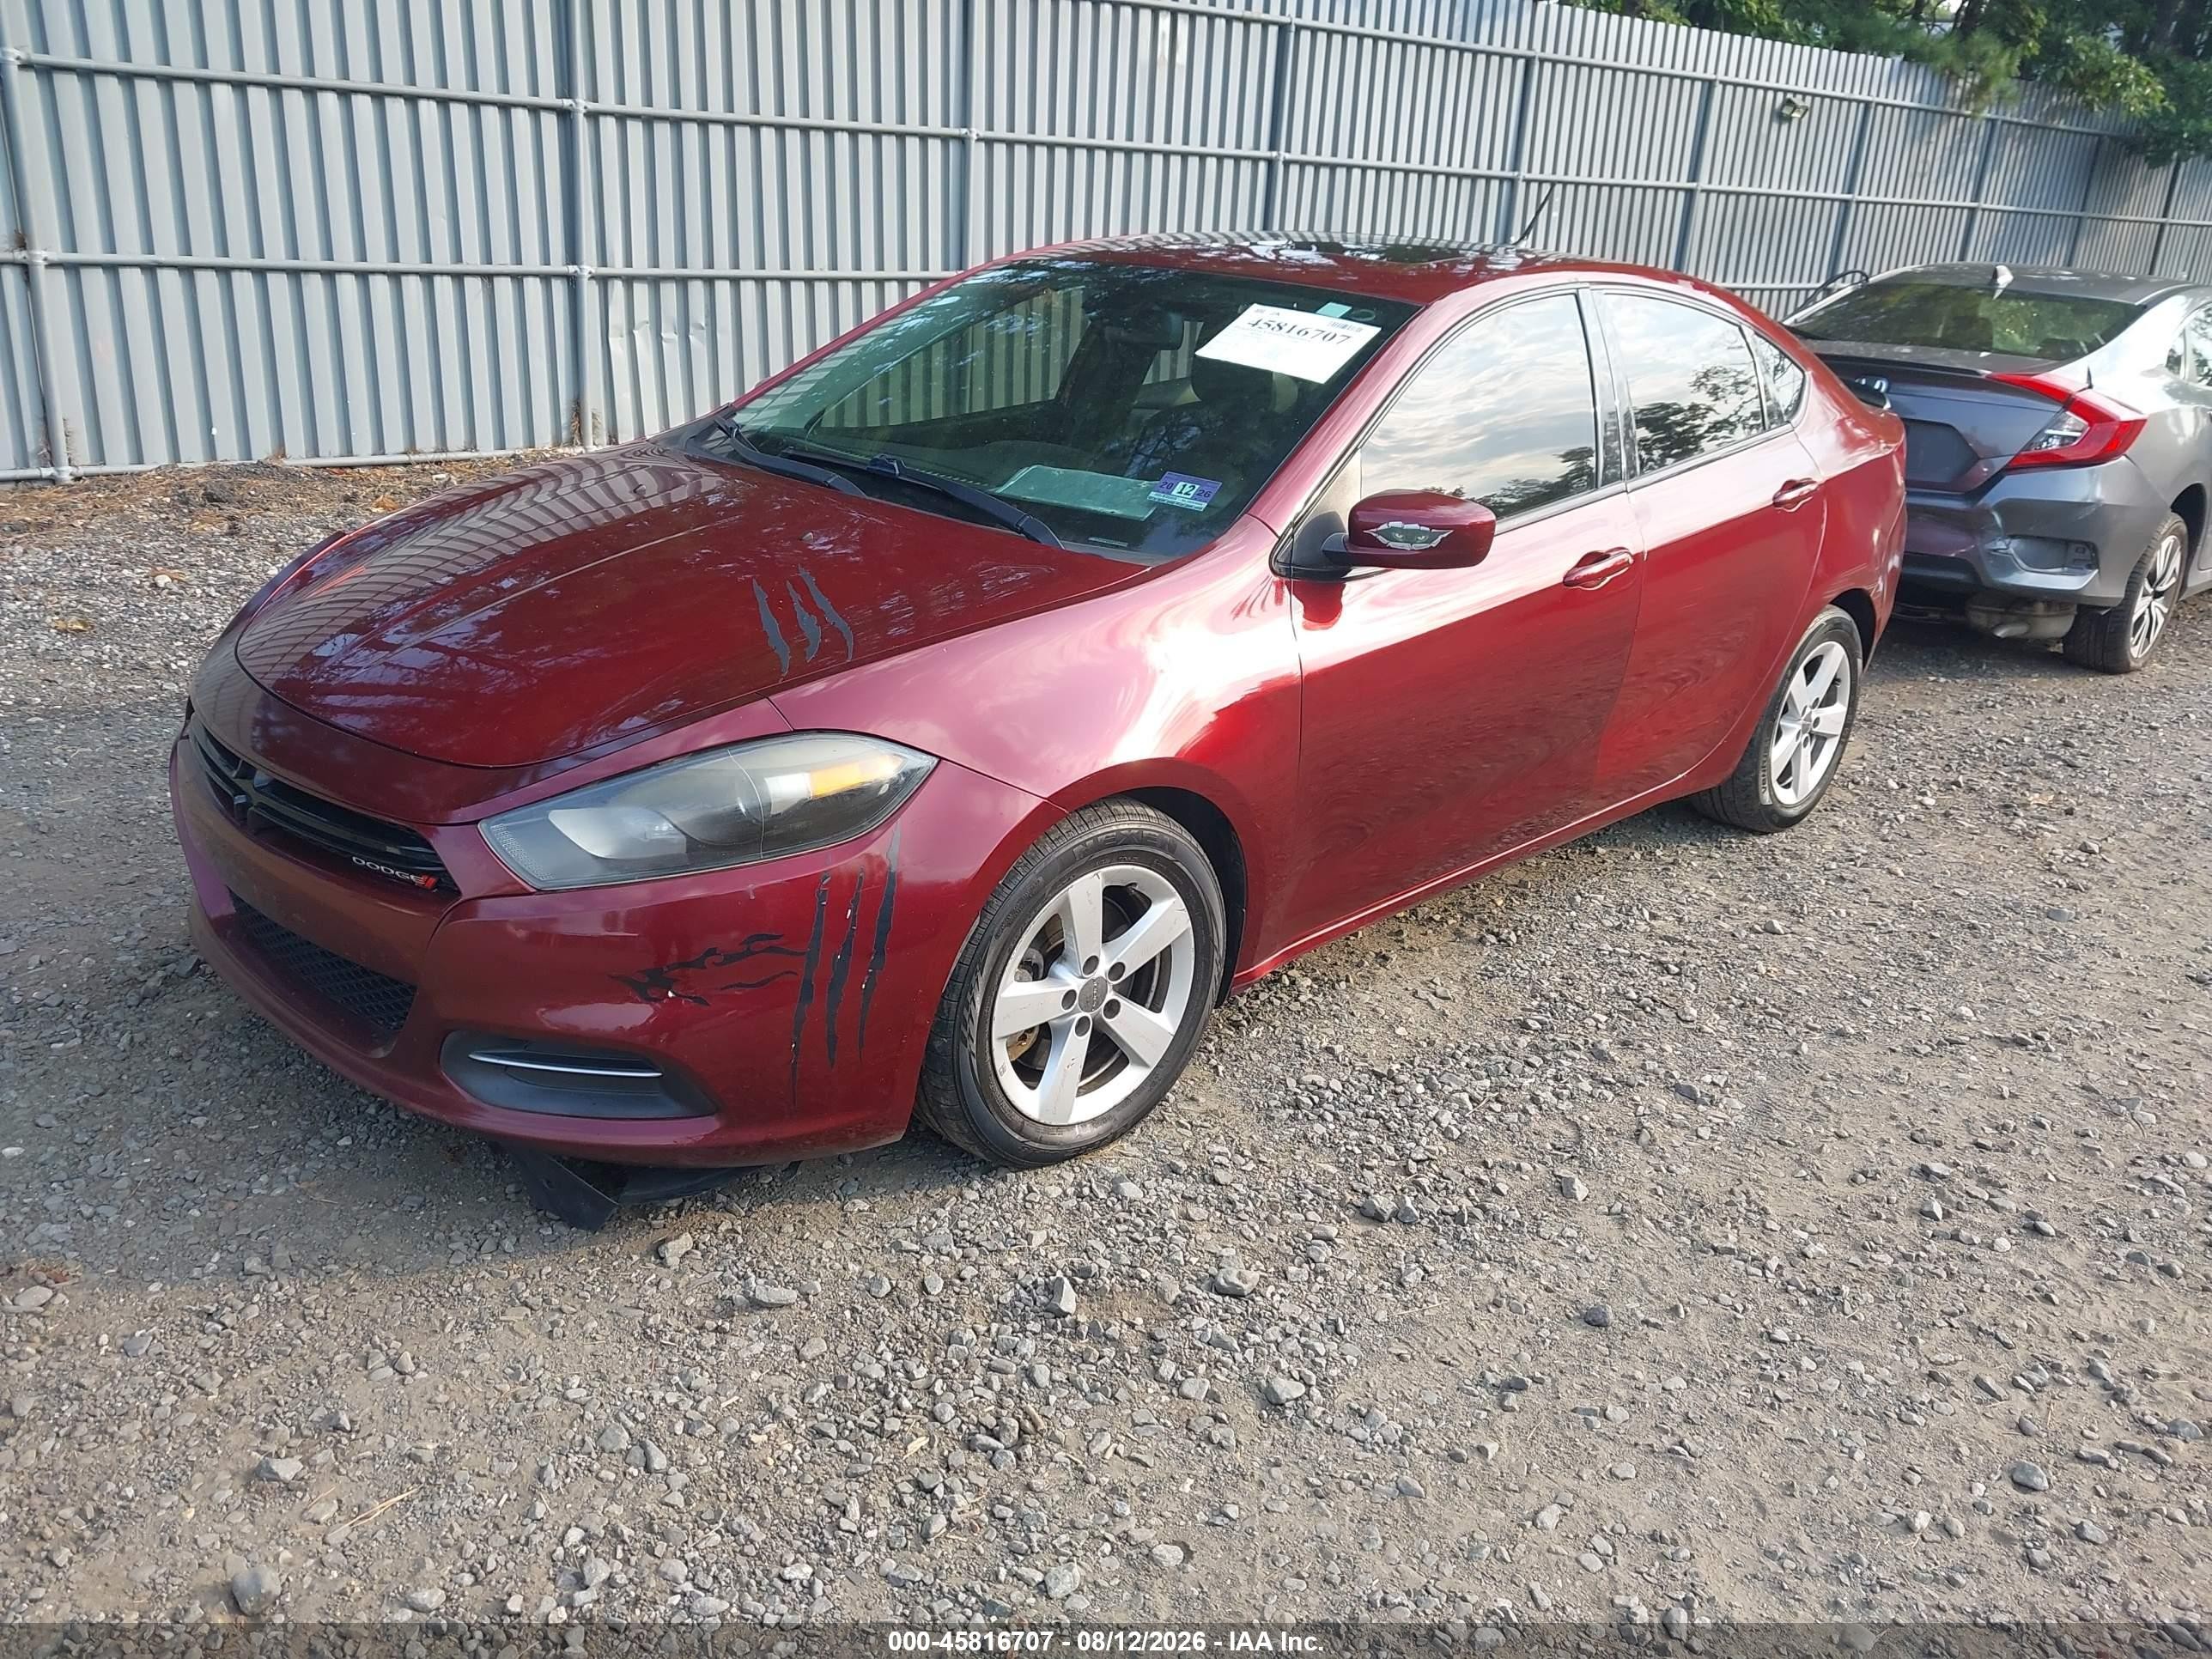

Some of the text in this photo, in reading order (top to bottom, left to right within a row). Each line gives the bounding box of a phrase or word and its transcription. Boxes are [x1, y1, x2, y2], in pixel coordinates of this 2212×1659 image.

[1248, 319, 1352, 344] 45816707
[1159, 481, 1212, 498] 20 12 26
[1073, 830, 1177, 860] NEXEN
[352, 856, 426, 886] DODGE
